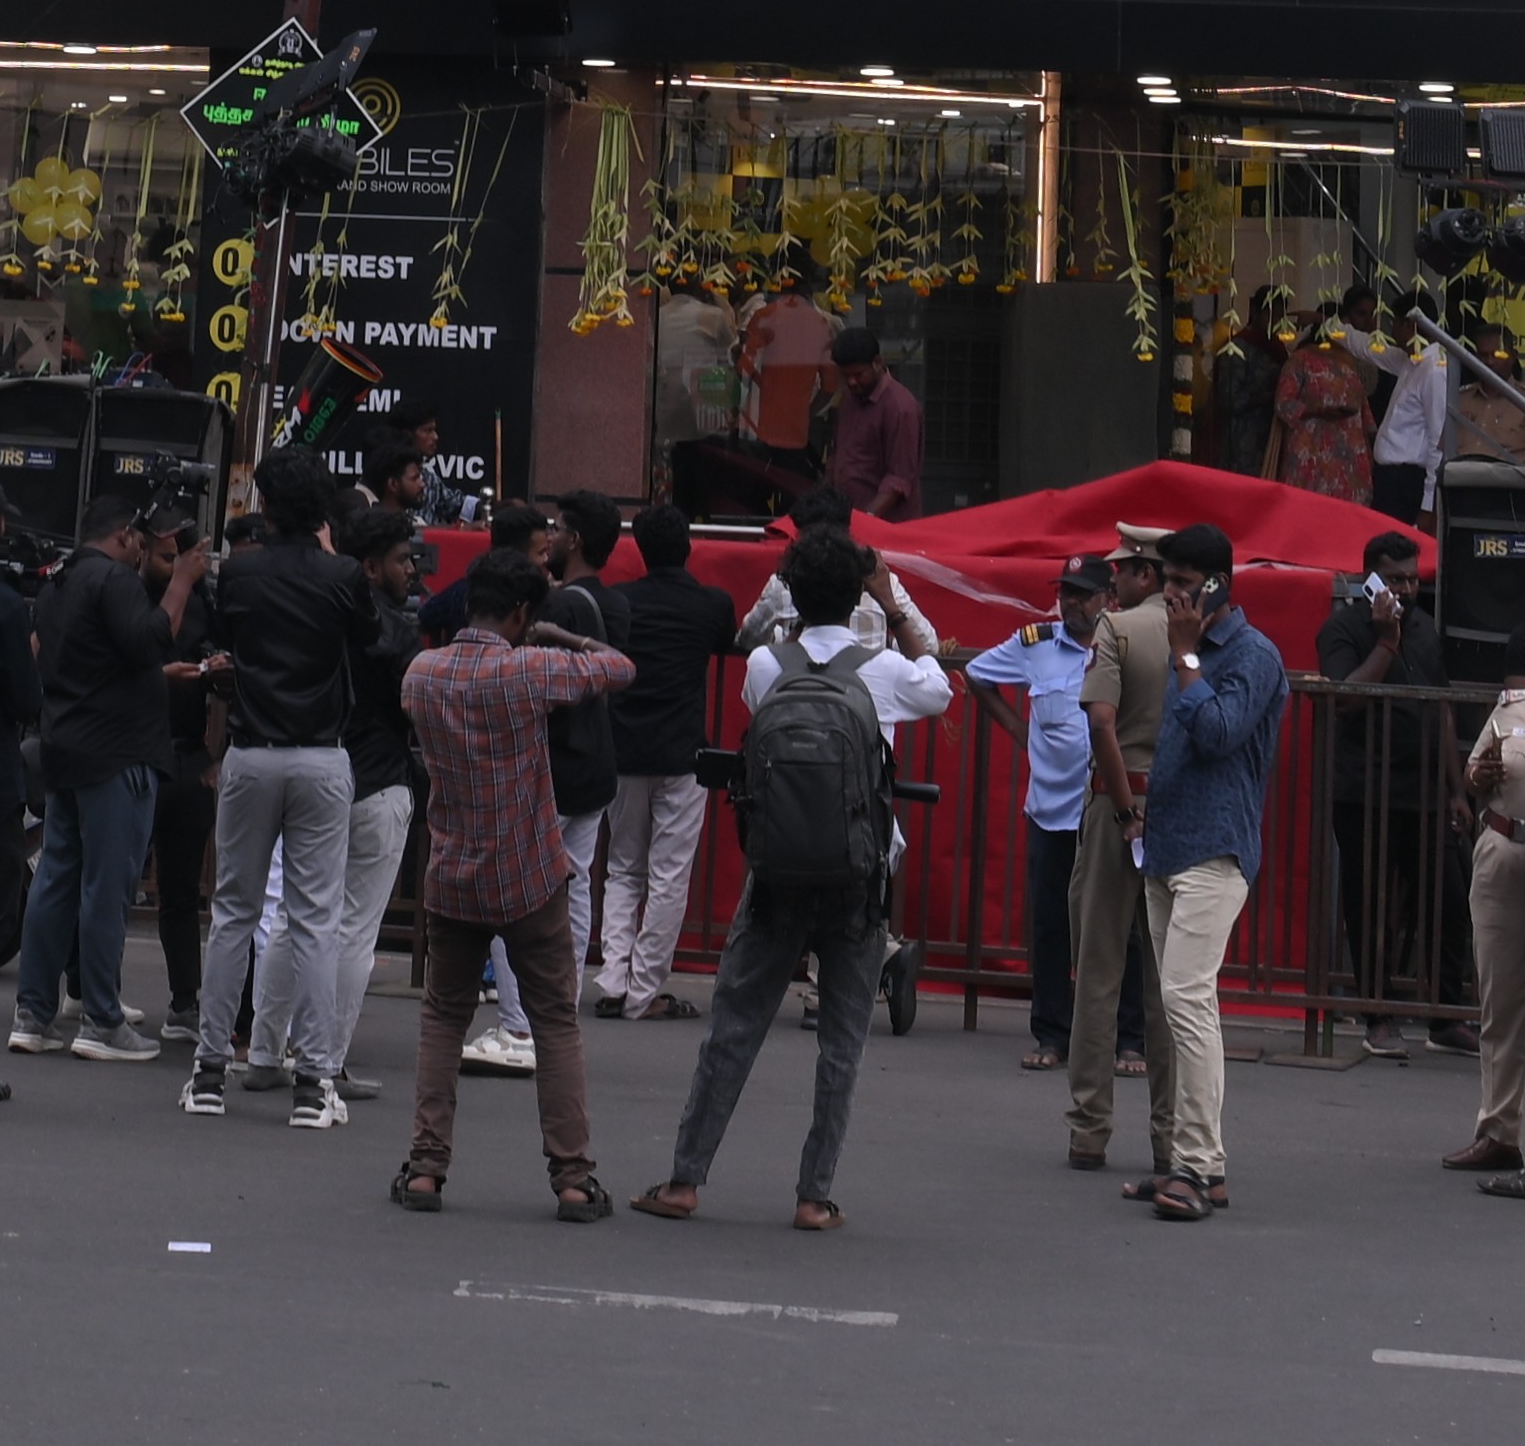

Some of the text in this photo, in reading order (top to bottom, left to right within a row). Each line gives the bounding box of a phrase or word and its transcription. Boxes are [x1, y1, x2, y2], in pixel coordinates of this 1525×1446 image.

[359, 147, 455, 178] BILES
[370, 181, 408, 194] SHOW
[412, 182, 451, 195] ROOM
[289, 252, 414, 280] NTEREST
[364, 322, 497, 350] PAYMENT
[115, 457, 144, 475] JRS
[1476, 539, 1508, 556] JRS
